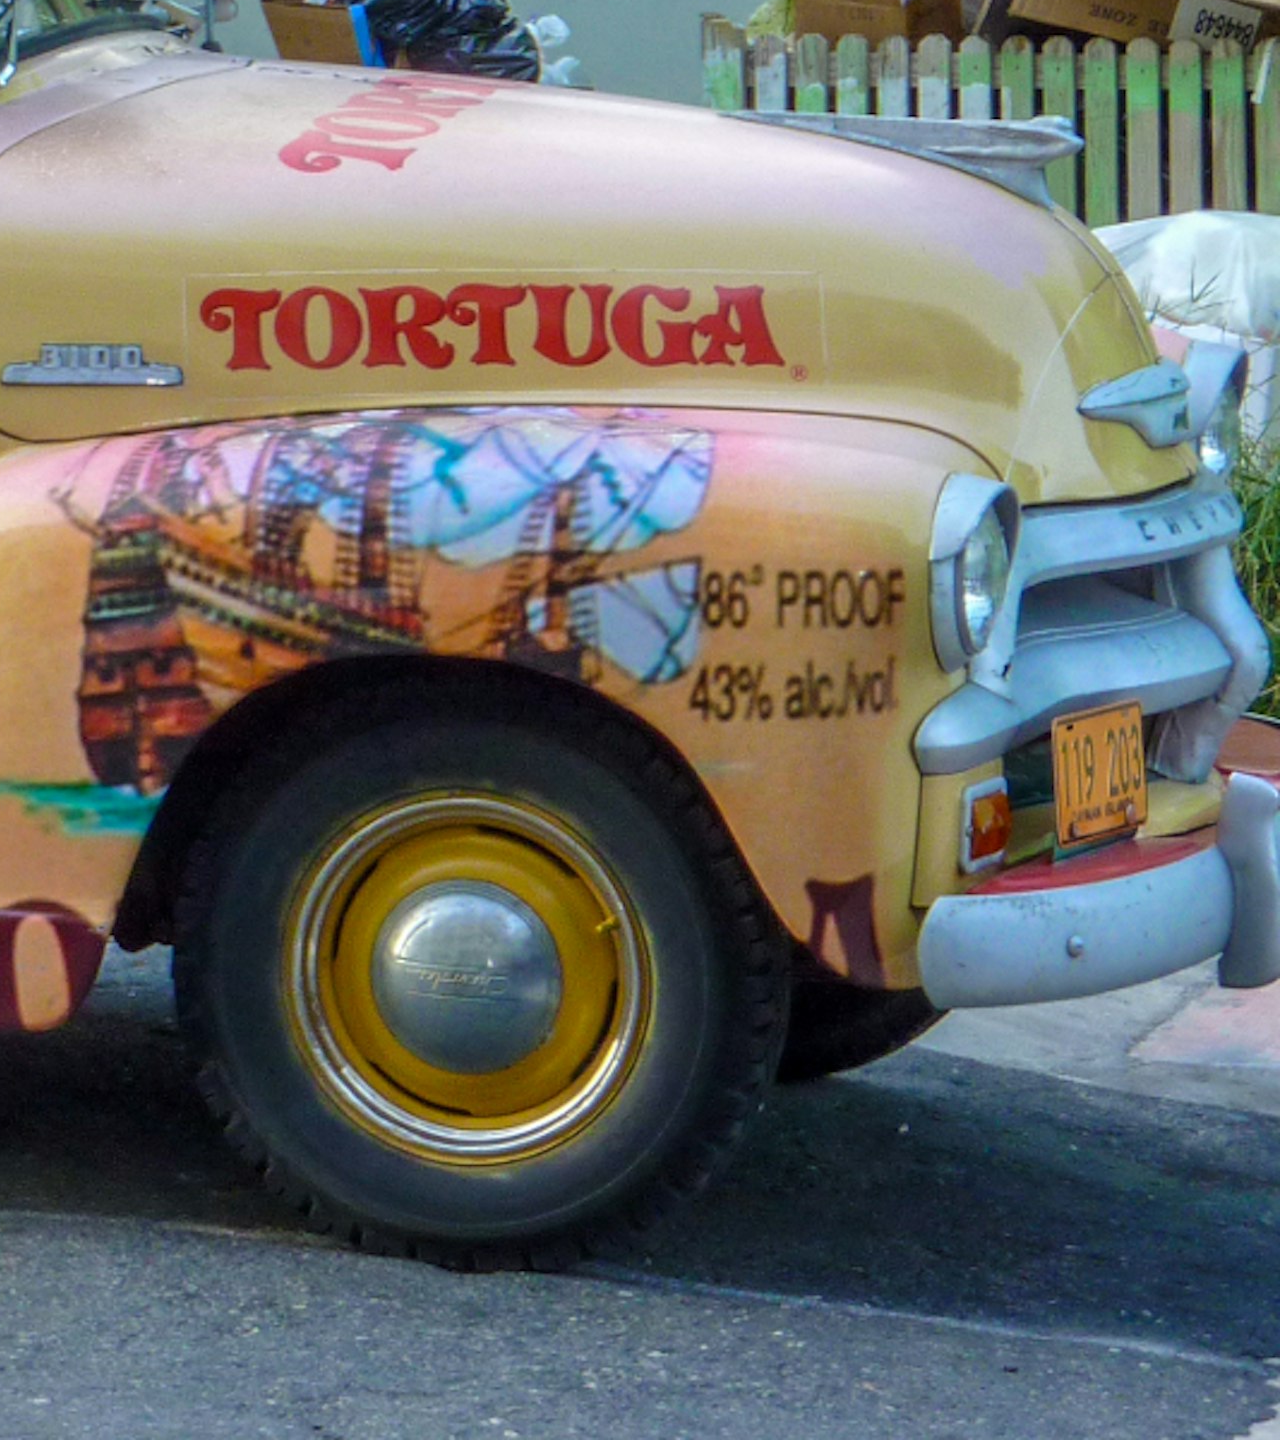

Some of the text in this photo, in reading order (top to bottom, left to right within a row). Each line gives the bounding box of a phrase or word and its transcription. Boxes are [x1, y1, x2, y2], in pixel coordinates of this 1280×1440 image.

[198, 282, 786, 373] TORTUGA
[776, 567, 905, 631] PROOF
[689, 662, 774, 722] 43%
[1061, 723, 1142, 808] 119 203
